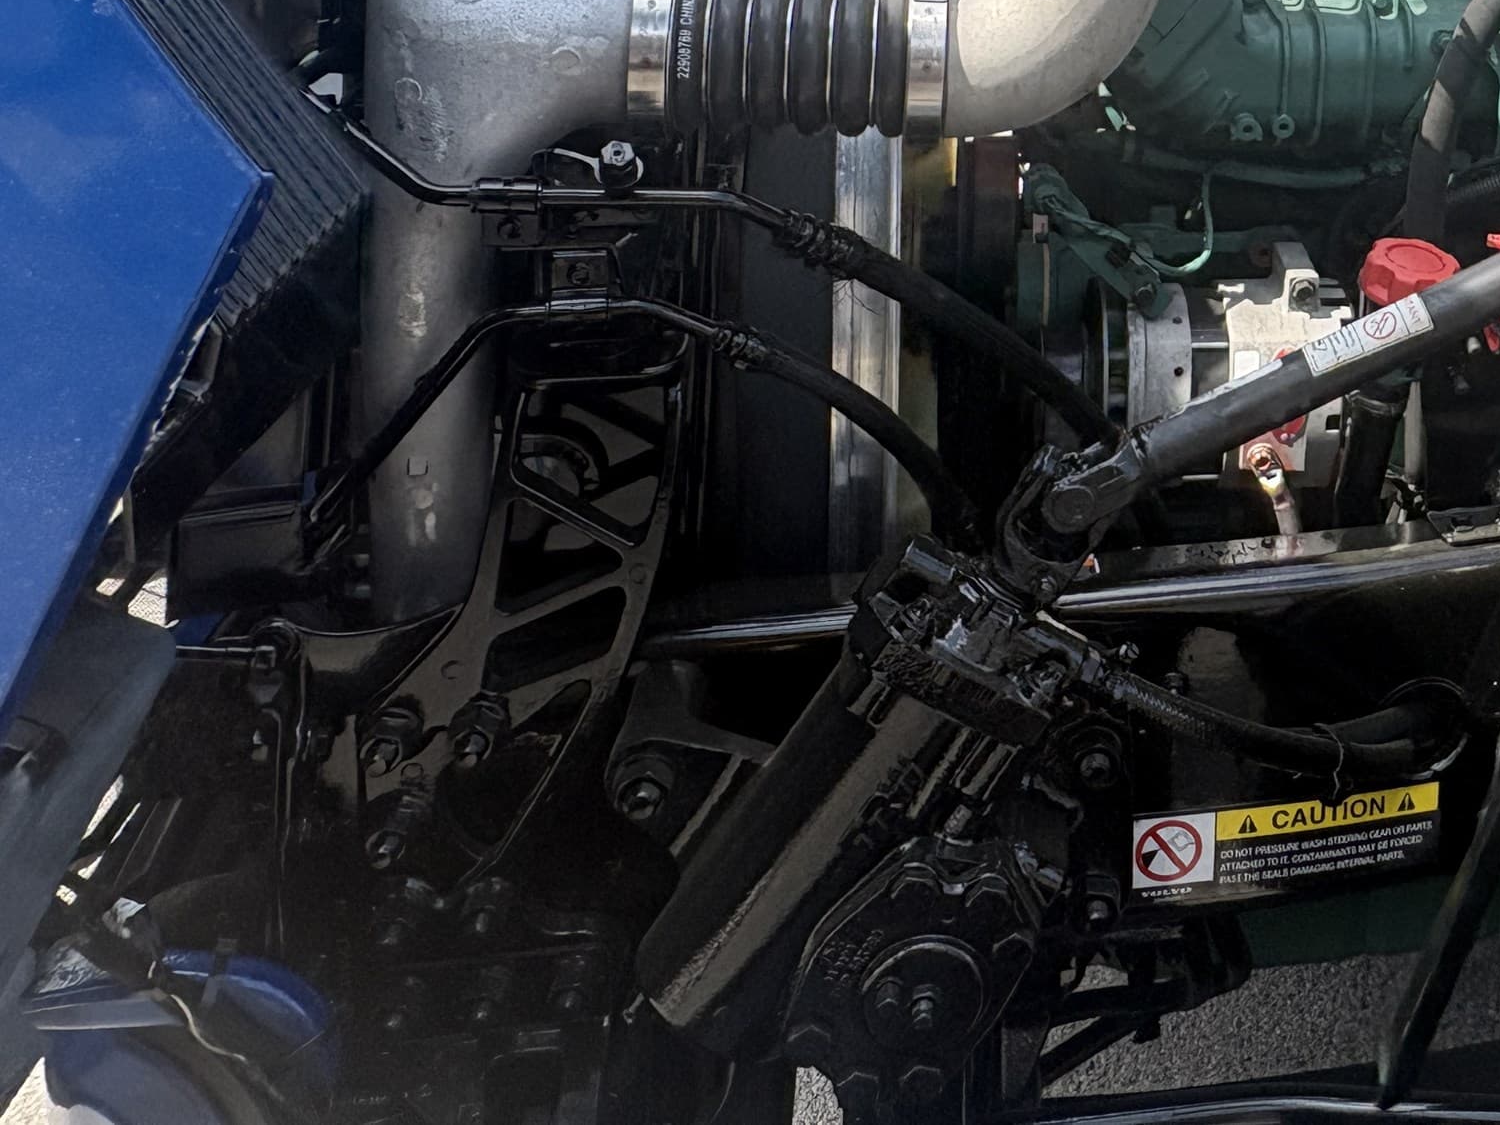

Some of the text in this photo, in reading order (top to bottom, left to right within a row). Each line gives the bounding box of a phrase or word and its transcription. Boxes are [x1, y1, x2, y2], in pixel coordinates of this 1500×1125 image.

[1271, 795, 1386, 830] CAUTION
[1220, 850, 1234, 859] DO
[1235, 847, 1253, 857] NOT
[1255, 841, 1300, 855] PRESSURE
[1301, 838, 1326, 850] WASH
[1405, 820, 1433, 833] PARTS
[1219, 873, 1244, 884] PAST
[1244, 871, 1260, 881] THE
[1262, 868, 1289, 879] SEALS
[1289, 861, 1336, 876] DAMAGING
[1220, 859, 1266, 872] ATTACHED
[1267, 857, 1279, 866] TO
[1358, 842, 1376, 853] MAY
